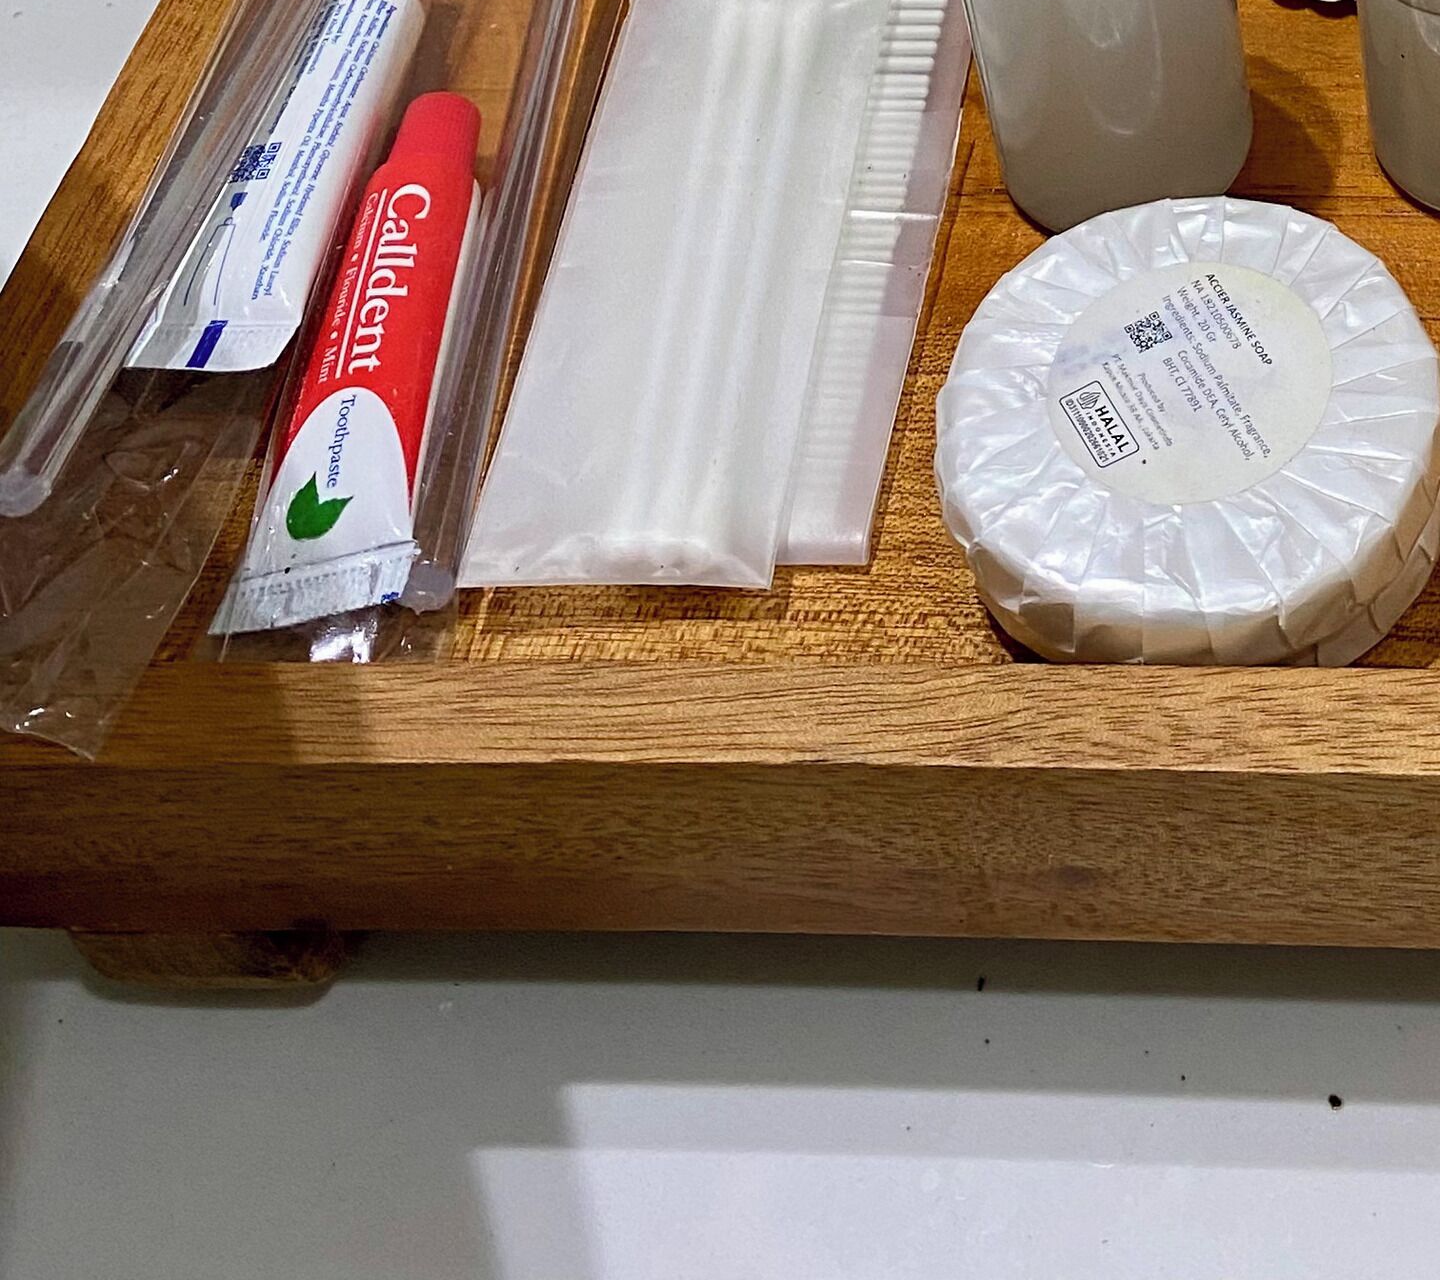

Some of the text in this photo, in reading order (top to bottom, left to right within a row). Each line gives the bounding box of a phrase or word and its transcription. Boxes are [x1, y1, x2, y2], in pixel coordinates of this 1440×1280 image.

[353, 192, 379, 252] Calcium
[348, 183, 431, 374] Calldent
[1191, 280, 1205, 293] NA
[1161, 295, 1196, 343] Ingredients:
[1192, 343, 1217, 374] Sodium
[1197, 319, 1210, 331] 20
[1205, 273, 1273, 366] ACCIER JASMINE SOAP
[317, 344, 338, 384] Mint
[1177, 350, 1207, 388] Cocamide
[326, 394, 357, 489] Toothpaste
[1086, 412, 1115, 456] INDONESIA
[1095, 405, 1130, 452] HALAL
